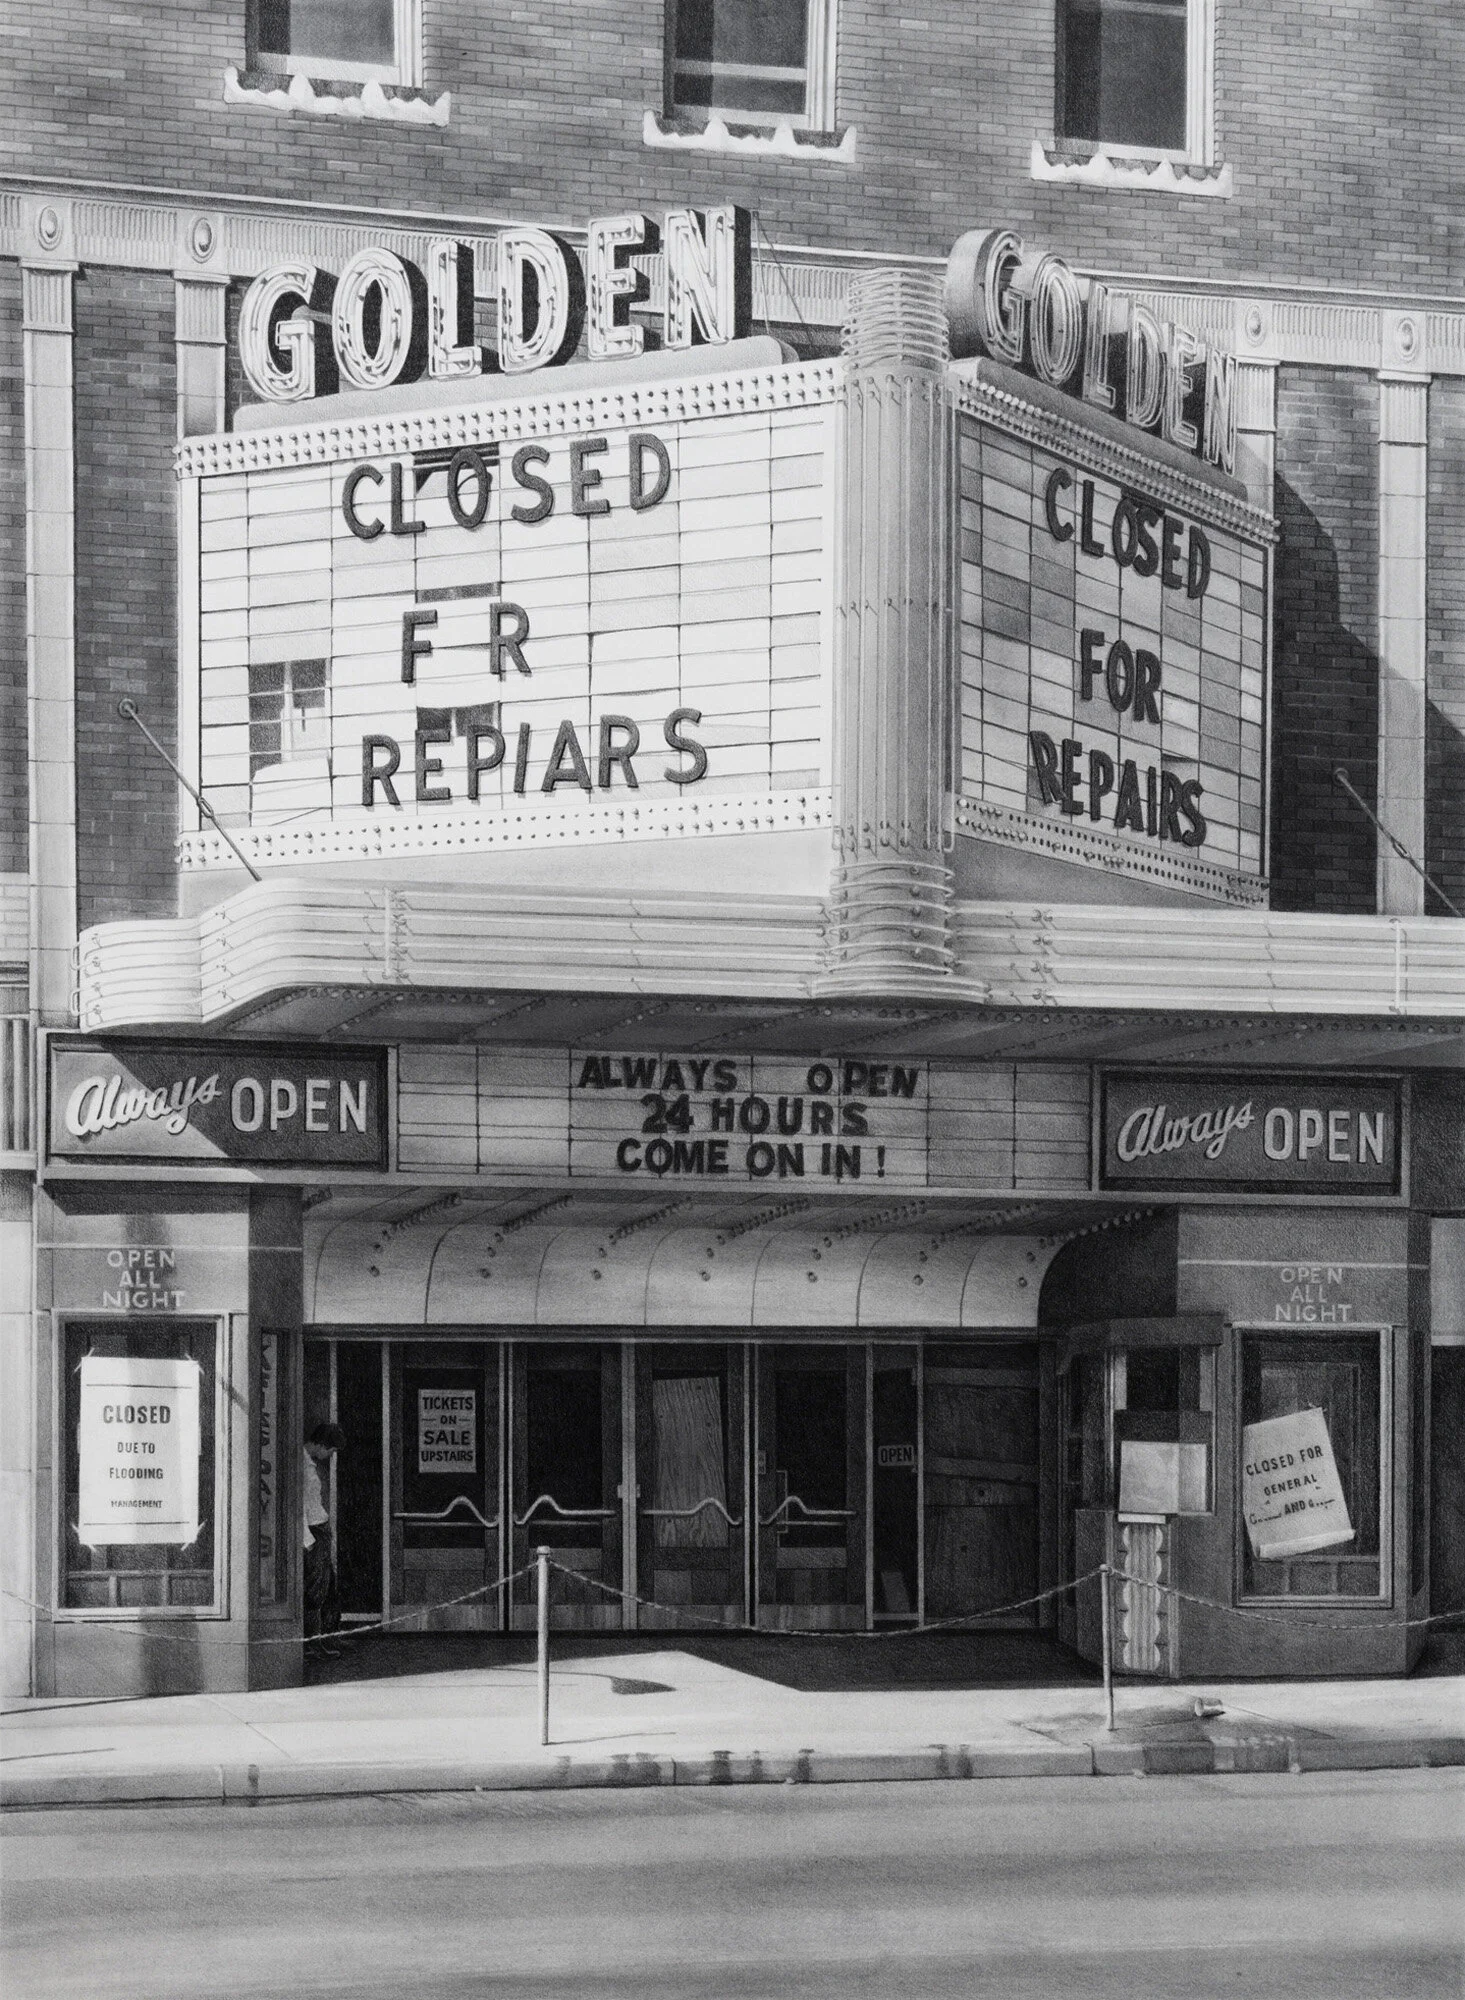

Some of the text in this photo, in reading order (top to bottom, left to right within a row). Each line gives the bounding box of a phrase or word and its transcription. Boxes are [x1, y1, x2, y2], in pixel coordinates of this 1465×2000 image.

[239, 205, 747, 403] GOLDEN
[947, 229, 1239, 476] GOLDEN
[342, 433, 672, 540] CLOSED
[1045, 467, 1212, 601] CLOSED
[1080, 628, 1163, 724] FOR
[362, 708, 710, 806] REPIARS
[1030, 730, 1208, 847] REPAIRS
[577, 1055, 920, 1099] ALWAYS OPEN
[66, 1071, 368, 1138] Always OPEN
[640, 1093, 869, 1137] 24 HOURS
[1117, 1101, 1386, 1164] Always OPEN
[616, 1138, 730, 1175] COME
[746, 1141, 804, 1178] ON
[107, 1249, 175, 1268] OPEN
[119, 1269, 161, 1288] ALL
[1281, 1266, 1343, 1285] OPEN
[102, 1289, 186, 1308] NIGHT
[1290, 1284, 1328, 1303] ALL
[1275, 1303, 1352, 1322] NIGHT
[422, 1396, 474, 1411] TICKETS
[103, 1404, 171, 1425] CLOSED
[440, 1414, 457, 1425] ON
[423, 1429, 471, 1446] SALE
[117, 1441, 156, 1455] DUE TO
[421, 1450, 474, 1462] UPSTAIRS
[880, 1446, 913, 1464] OPEN
[1245, 1445, 1324, 1477] CLOSED FOR
[109, 1467, 164, 1480] FLOODING
[1263, 1473, 1318, 1497] GENERAL
[110, 1499, 163, 1509] MANAGEMENT
[1284, 1499, 1306, 1516] AND
